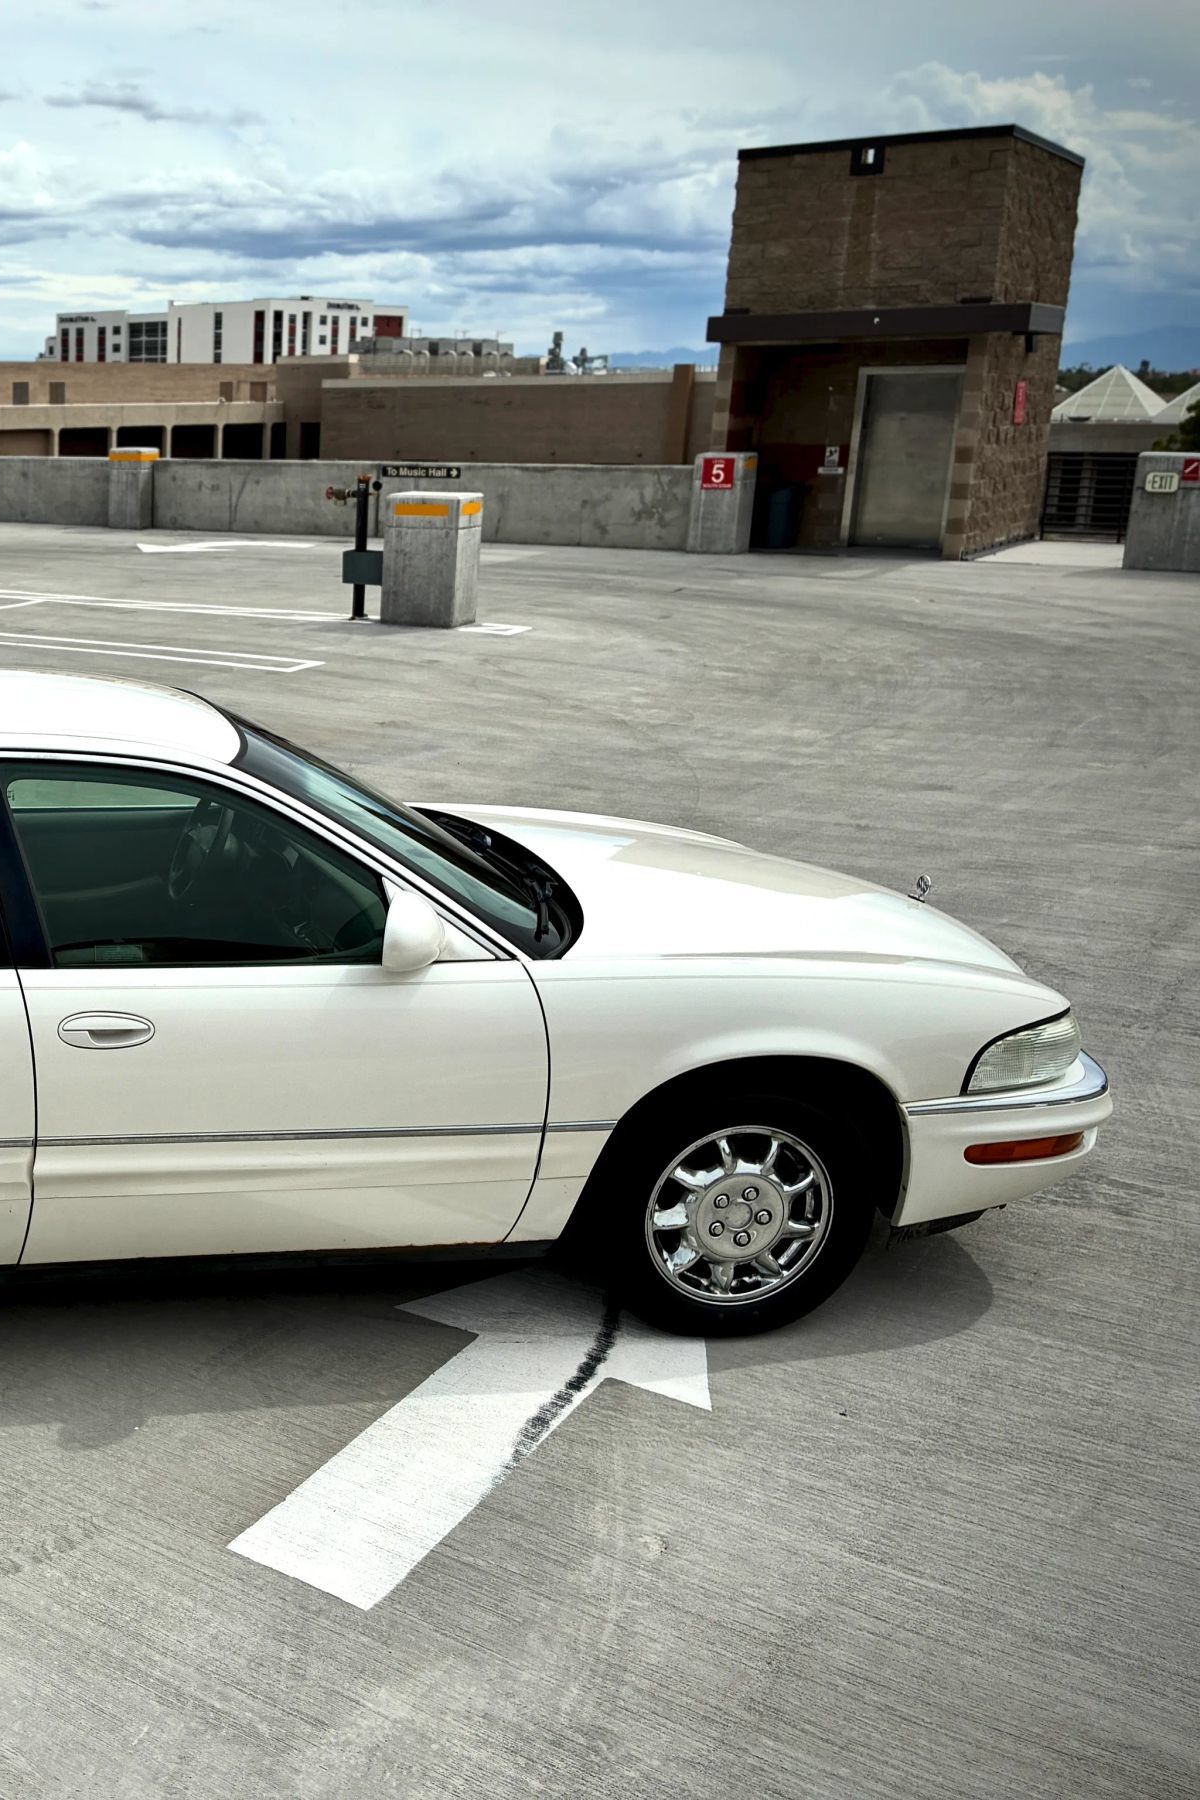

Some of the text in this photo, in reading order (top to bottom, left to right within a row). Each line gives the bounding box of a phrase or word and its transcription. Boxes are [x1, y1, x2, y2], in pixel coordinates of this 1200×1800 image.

[386, 467, 447, 477] To Music Hall
[711, 463, 725, 484] 5
[1151, 475, 1174, 490] EXIT
